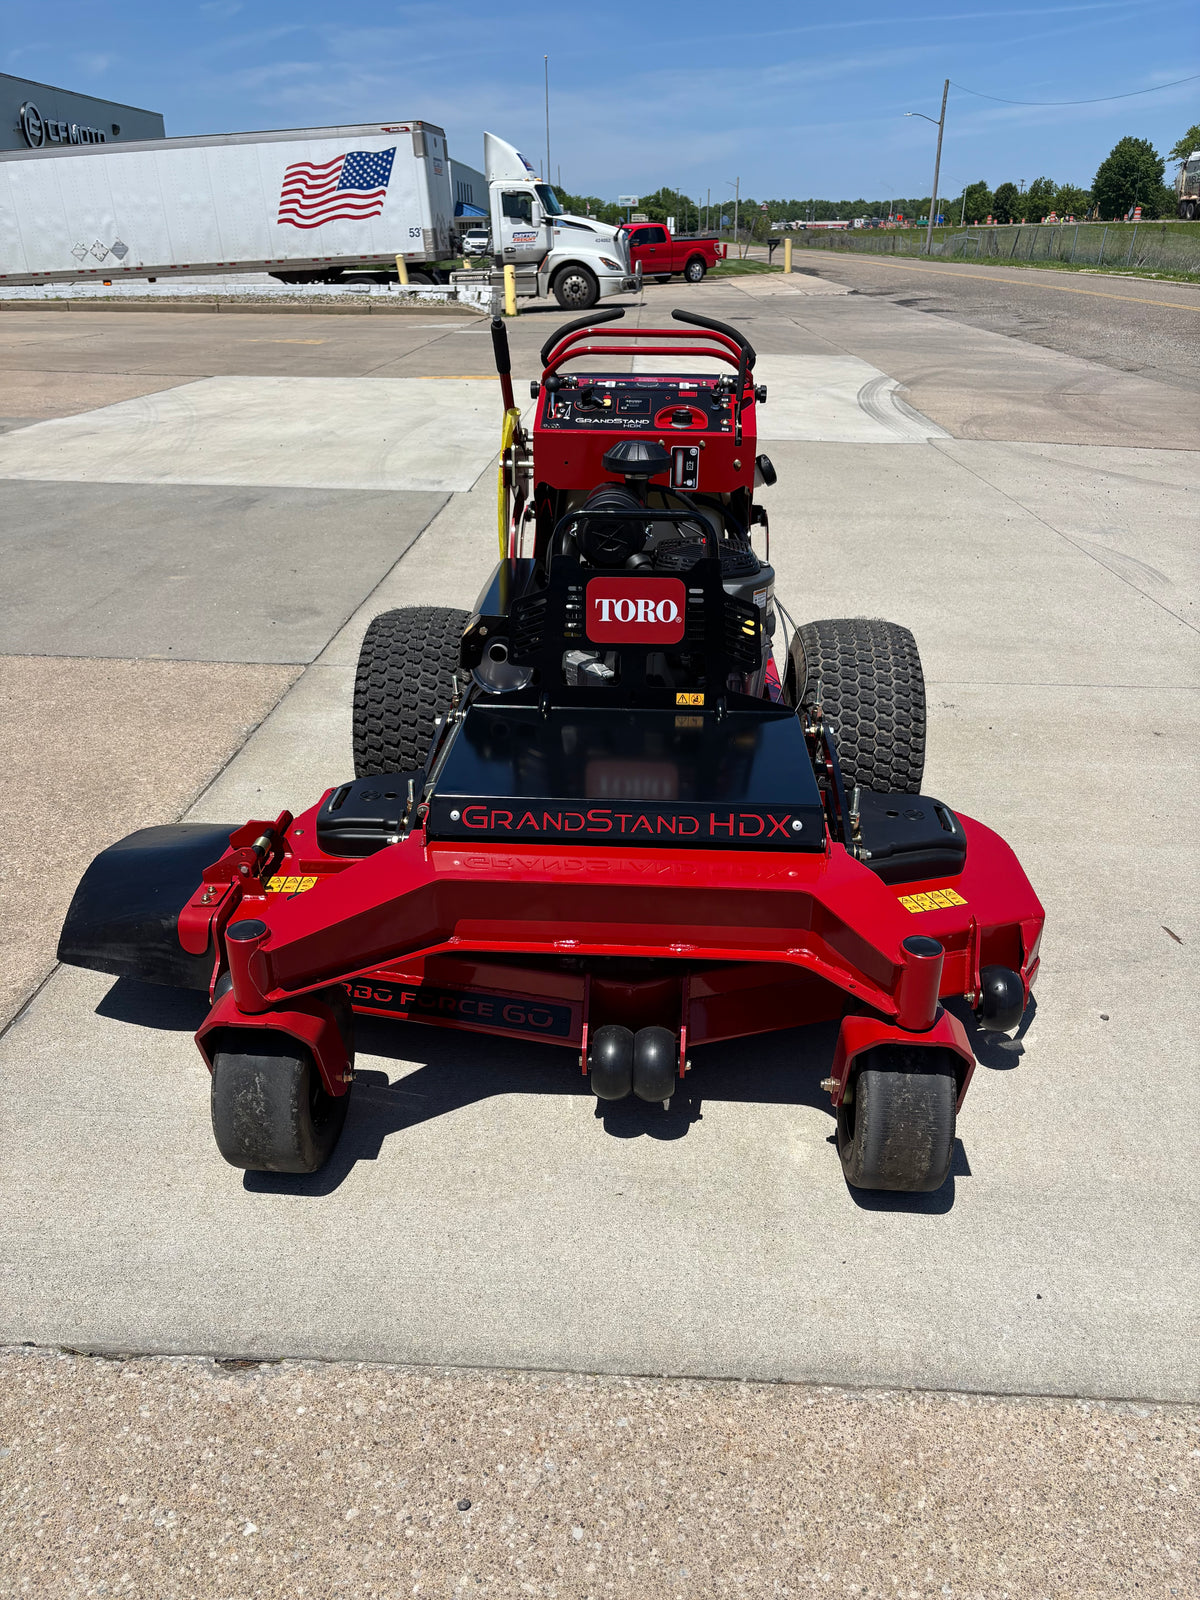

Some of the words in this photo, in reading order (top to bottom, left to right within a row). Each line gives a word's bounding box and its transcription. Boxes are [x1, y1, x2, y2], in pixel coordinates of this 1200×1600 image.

[45, 119, 106, 145] CFMOTO
[595, 598, 678, 623] TORO
[462, 805, 700, 835] GRANDSTAND
[709, 812, 792, 838] HDX
[341, 982, 393, 1002] RBO
[400, 992, 494, 1018] FORCE
